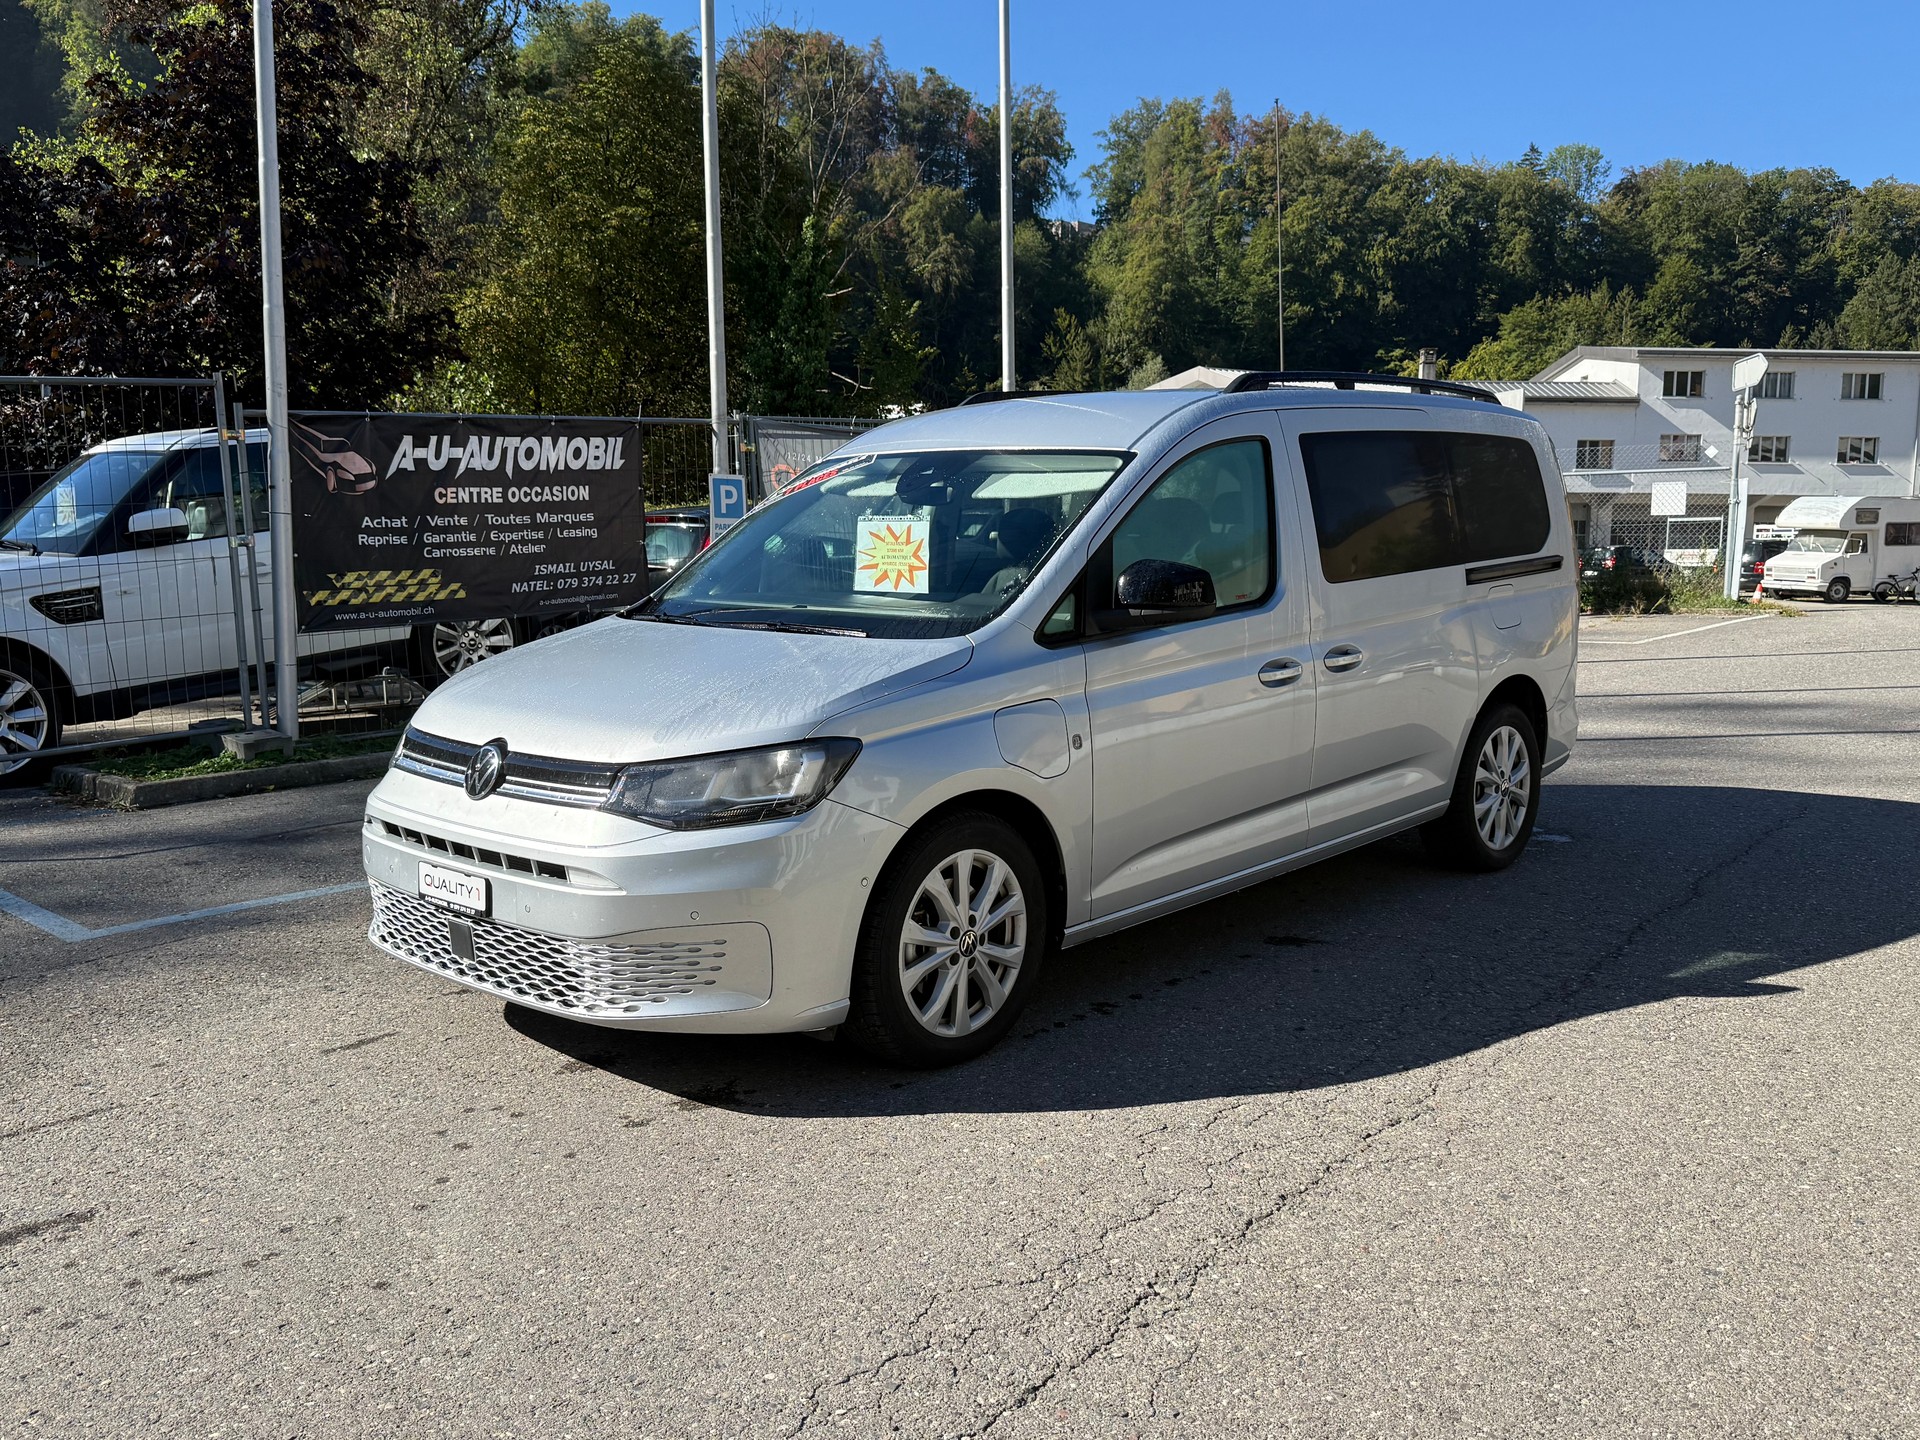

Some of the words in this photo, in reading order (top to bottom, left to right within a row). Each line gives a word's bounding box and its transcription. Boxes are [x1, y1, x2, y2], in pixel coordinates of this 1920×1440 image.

[385, 435, 626, 480] A-U-AUTOMOBIL
[434, 487, 504, 505] CENTRE
[507, 485, 590, 504] OCCASION
[720, 484, 738, 514] P
[361, 516, 409, 529] Achat
[426, 514, 469, 527] Vente
[484, 513, 531, 525] Toutes
[536, 512, 595, 525] Marques
[358, 533, 409, 548] Reprise
[423, 530, 477, 544] Garantie
[490, 529, 545, 543] Expertise
[557, 526, 598, 539] Leasing
[423, 546, 497, 558] Carrosserie
[509, 543, 547, 555] Atelier
[534, 562, 577, 576] ISMAIL
[580, 560, 616, 573] UYSAL
[511, 581, 554, 594] NATEL:
[557, 578, 579, 590] 079
[581, 576, 603, 588] 374
[605, 574, 619, 586] 22
[622, 573, 637, 584] 27
[334, 605, 435, 621] www.a-u-automobil.ch
[424, 873, 474, 899] QUALITY
